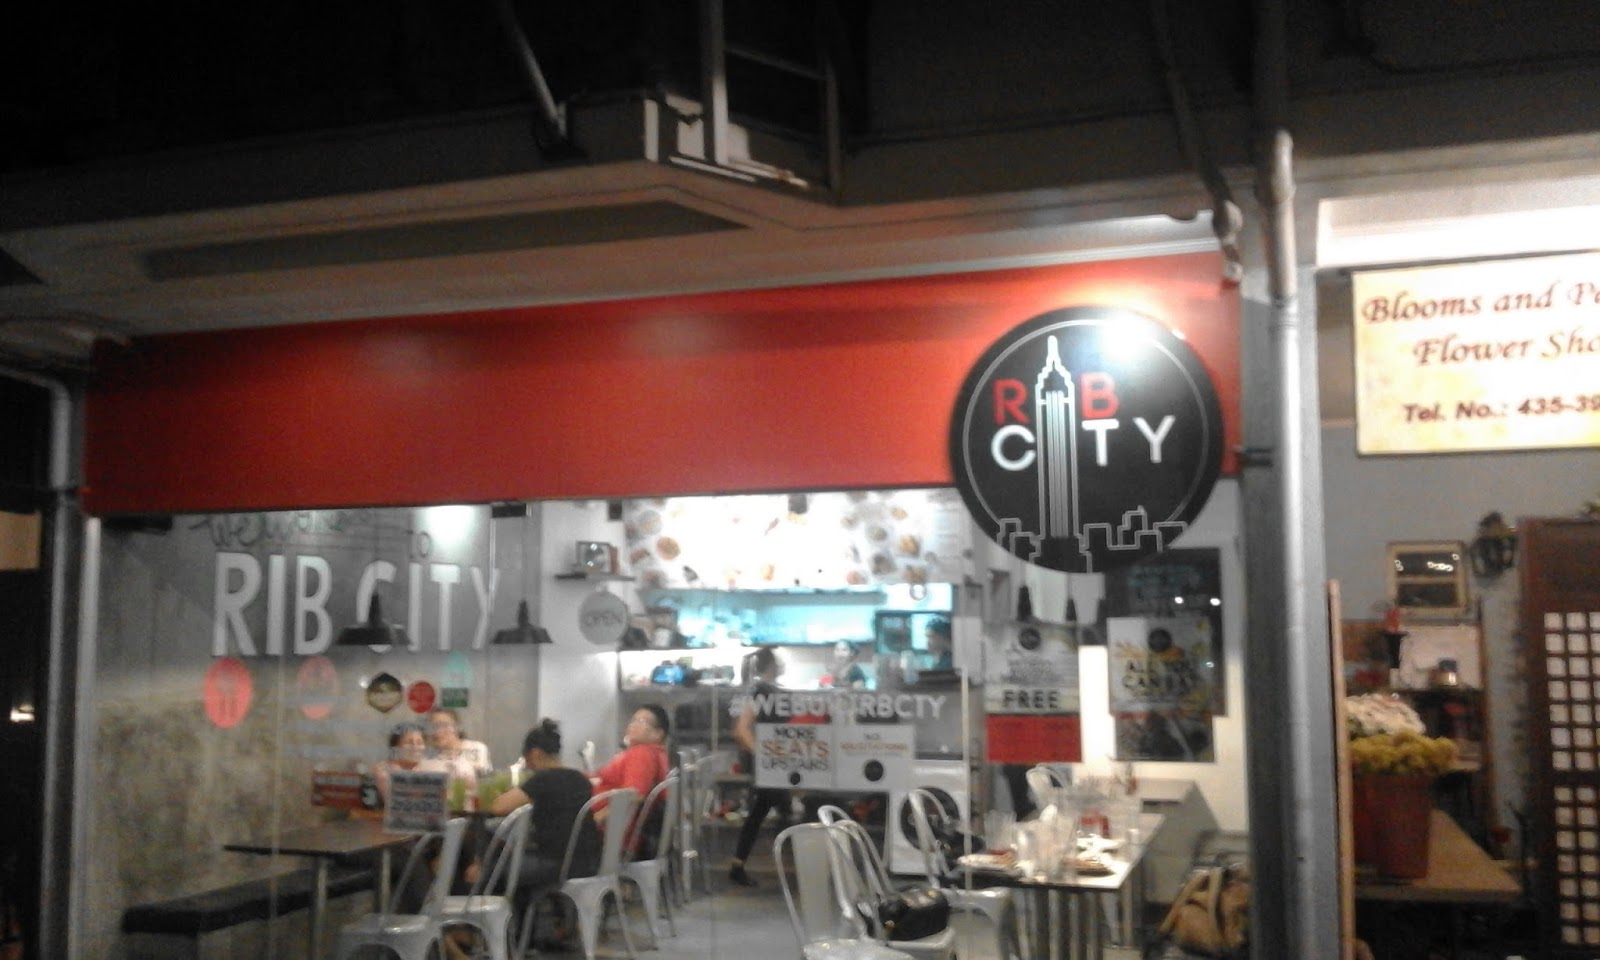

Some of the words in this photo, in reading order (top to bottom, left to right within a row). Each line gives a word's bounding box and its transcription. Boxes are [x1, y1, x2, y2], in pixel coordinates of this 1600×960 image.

[1361, 290, 1482, 324] Blooms
[1493, 279, 1561, 312] and
[1413, 333, 1533, 367] Flower
[211, 552, 334, 656] RIB
[1002, 689, 1060, 709] FREE
[774, 727, 816, 740] MORE
[761, 740, 830, 758] SEATS
